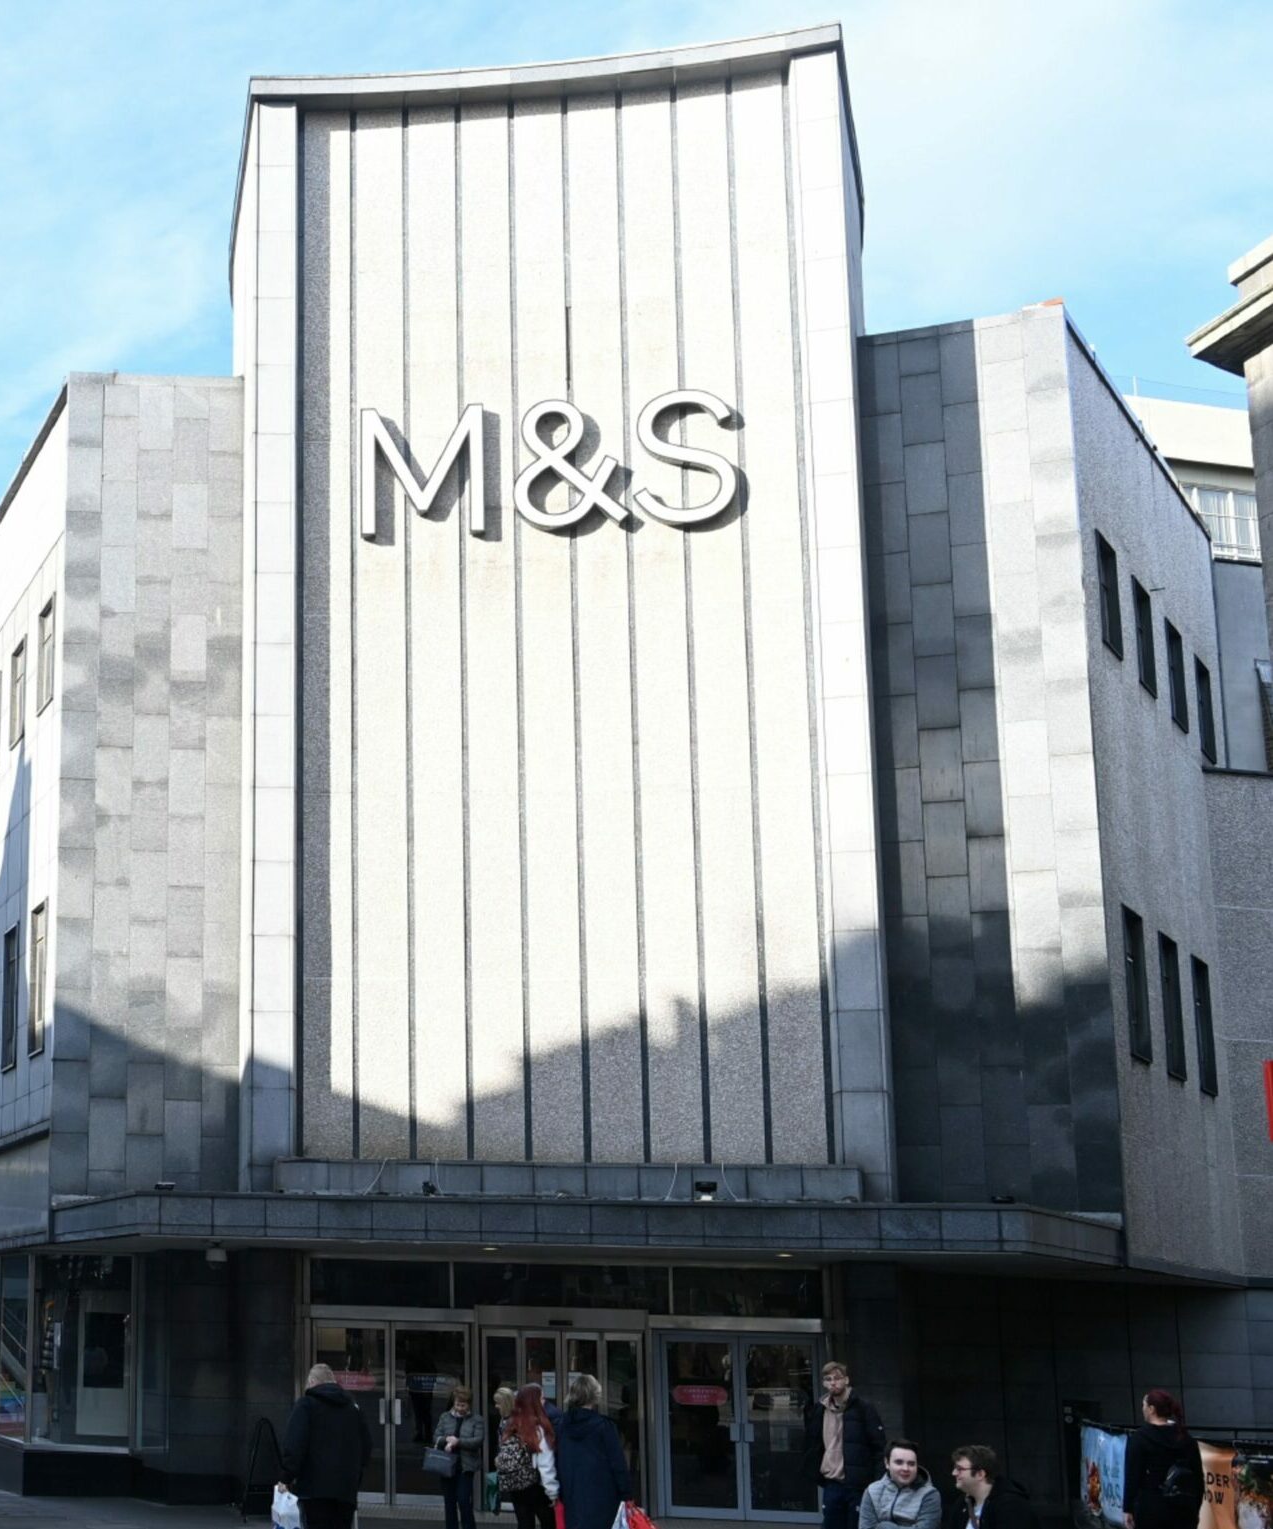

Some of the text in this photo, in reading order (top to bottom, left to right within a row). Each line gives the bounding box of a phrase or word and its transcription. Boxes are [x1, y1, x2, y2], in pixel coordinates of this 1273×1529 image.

[359, 388, 738, 540] M&S
[1206, 1471, 1230, 1489] DER
[1203, 1491, 1225, 1505] OW
